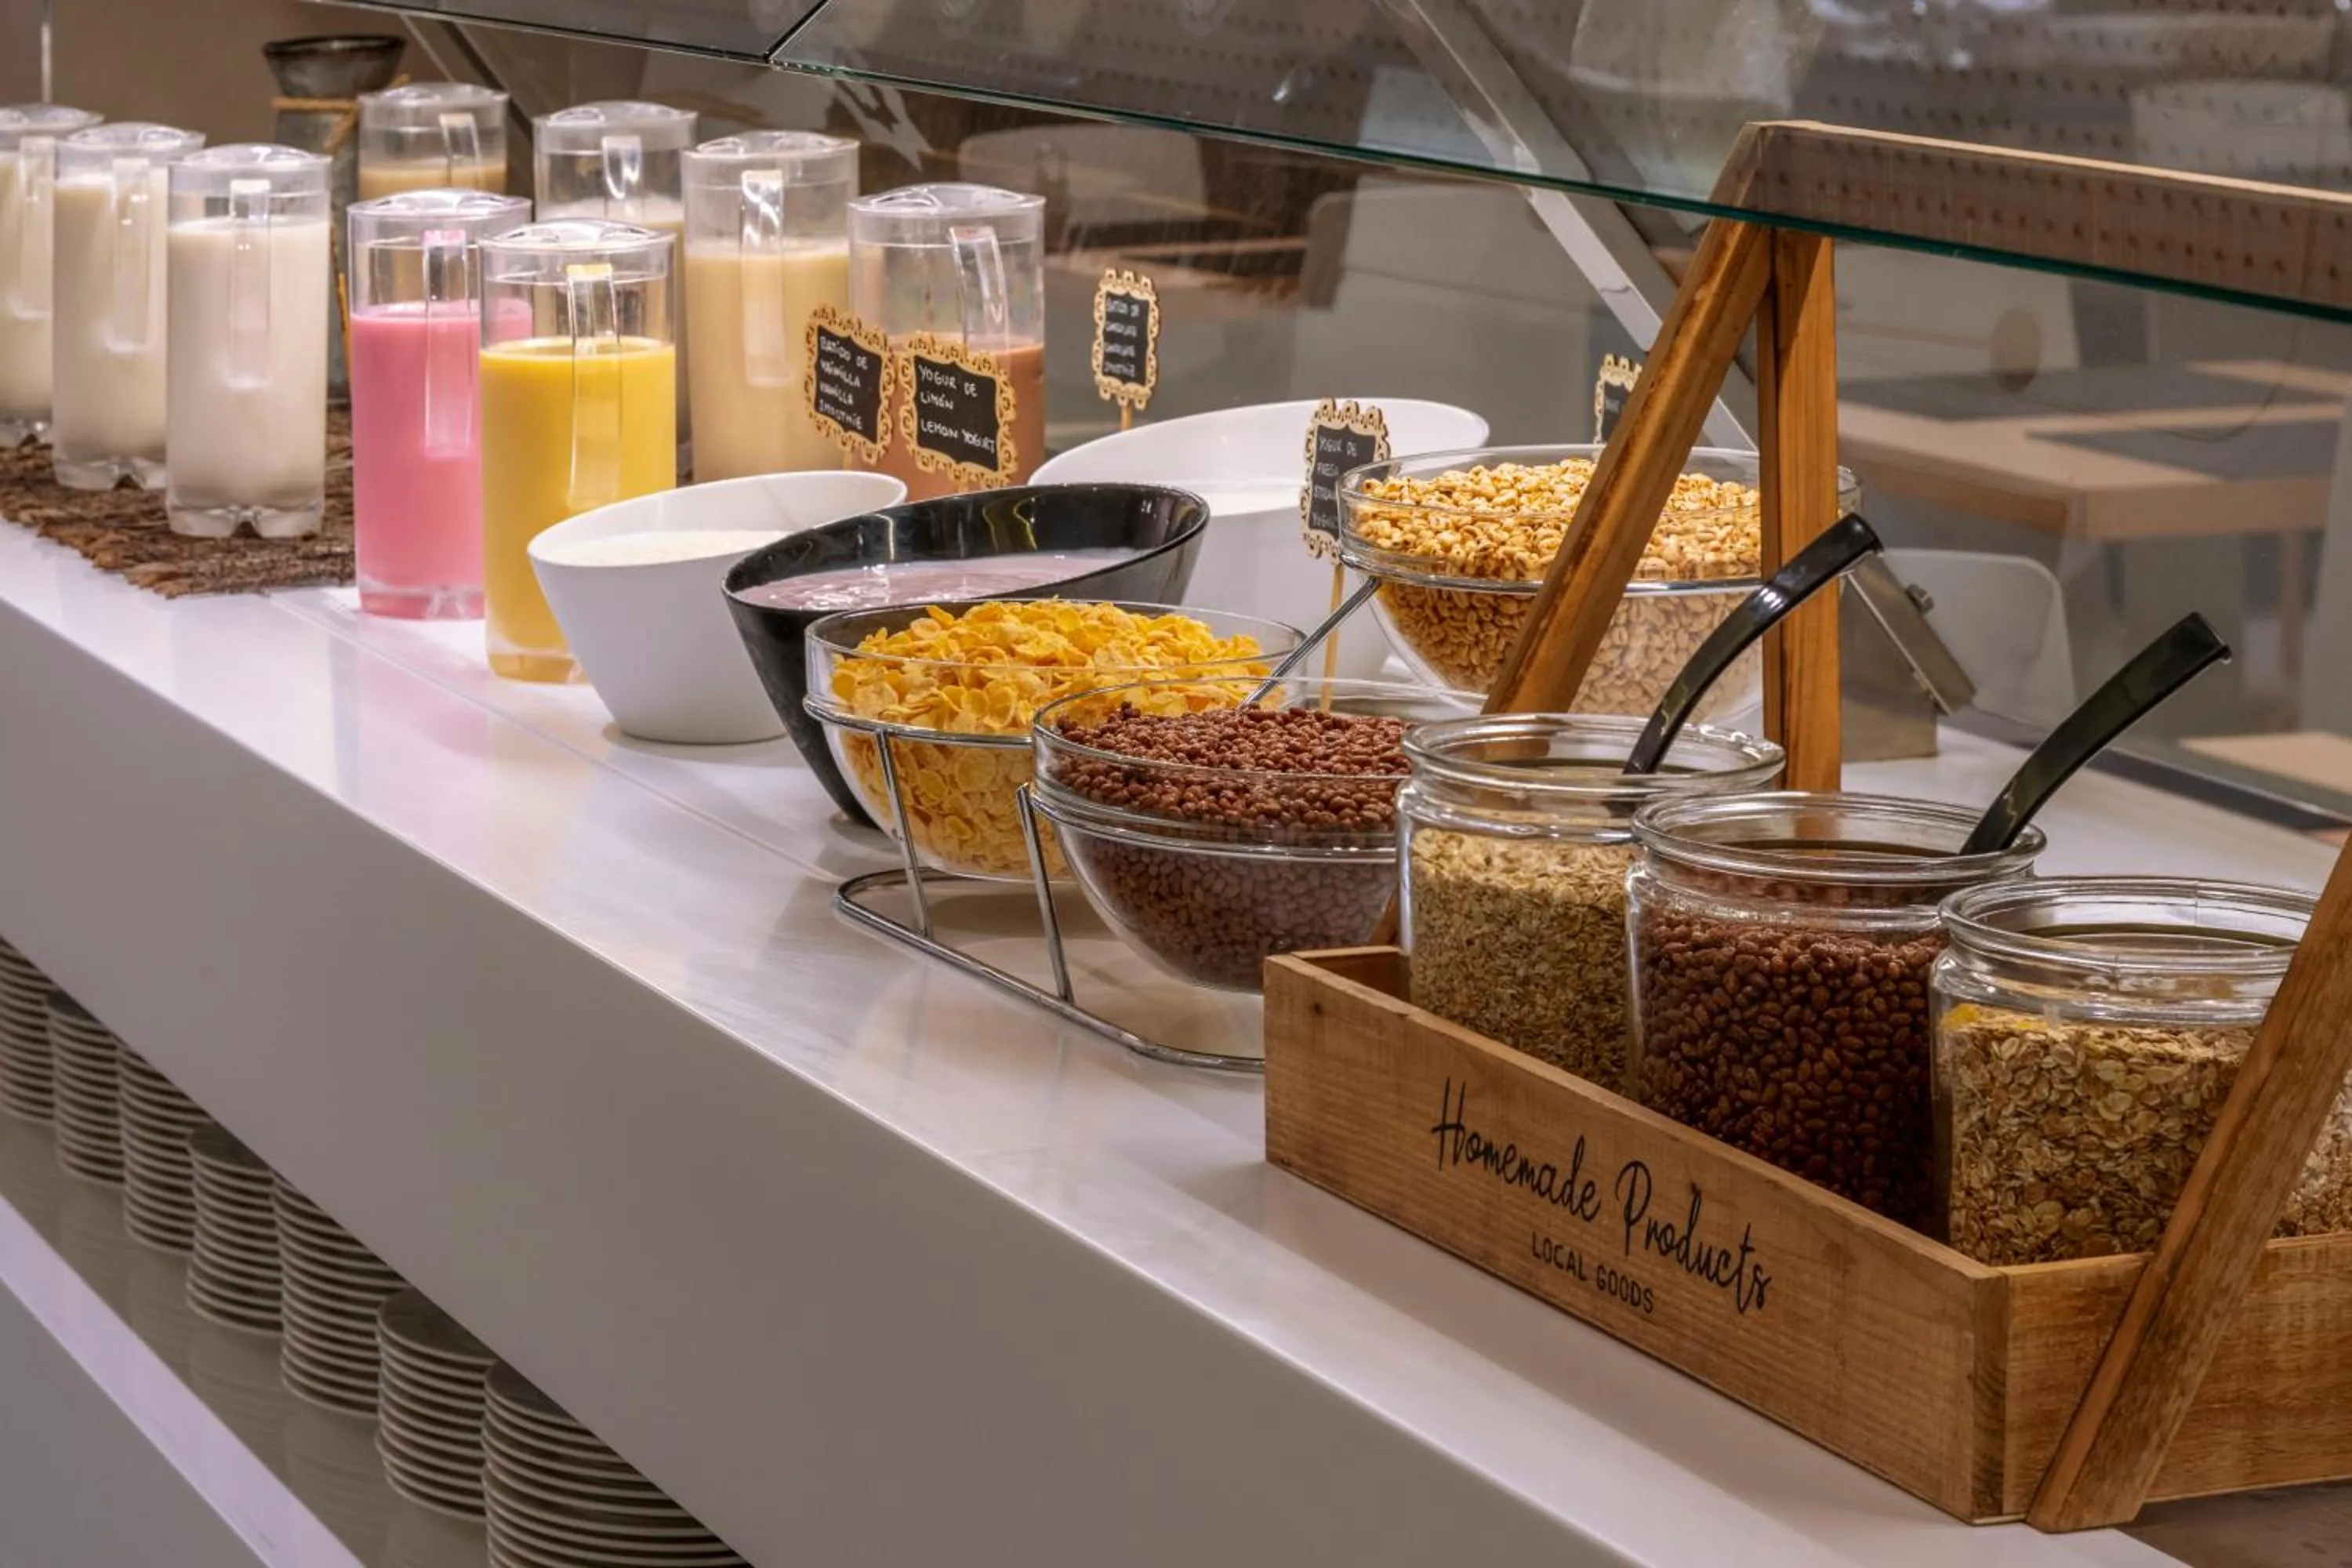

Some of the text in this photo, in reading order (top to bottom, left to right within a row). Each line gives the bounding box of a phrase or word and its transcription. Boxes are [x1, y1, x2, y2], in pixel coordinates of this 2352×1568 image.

[856, 355, 869, 372] DE
[918, 364, 978, 398] YOGUR DE
[920, 419, 959, 440] LEMON
[1430, 1076, 1772, 1316] Homemade Products
[1531, 1231, 1654, 1315] LOCAL GOODS
